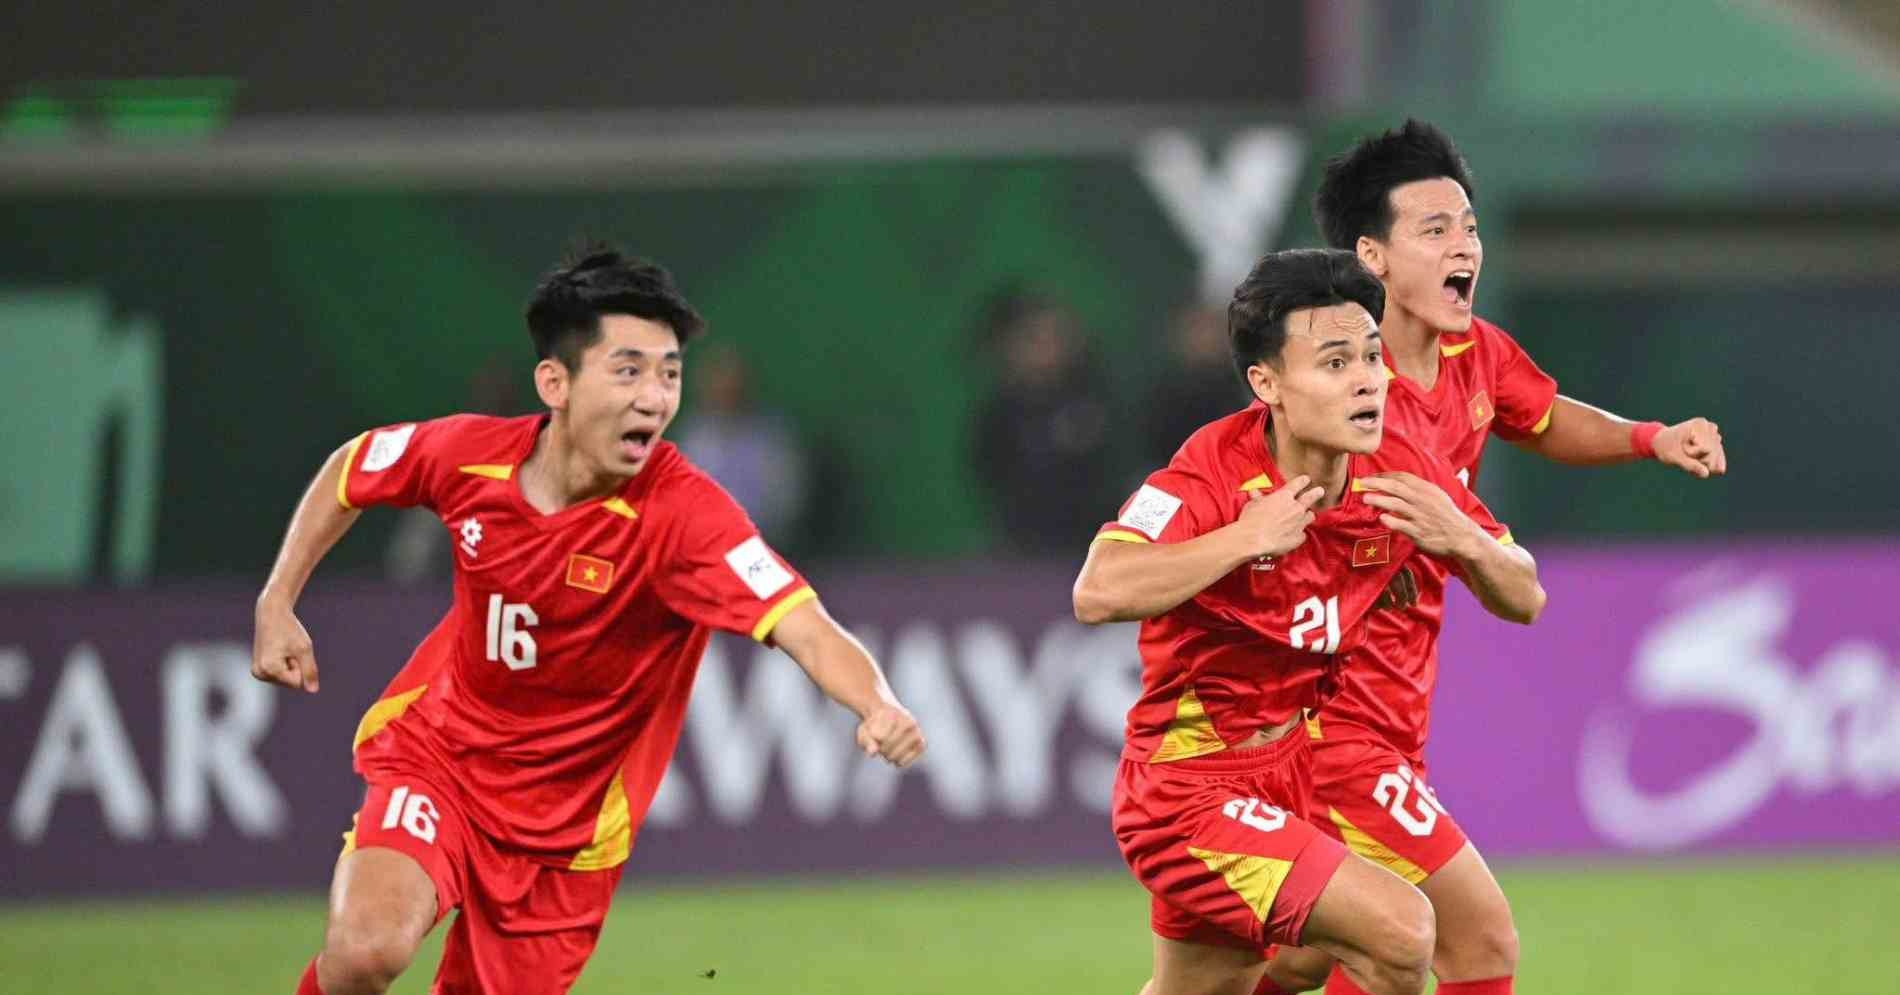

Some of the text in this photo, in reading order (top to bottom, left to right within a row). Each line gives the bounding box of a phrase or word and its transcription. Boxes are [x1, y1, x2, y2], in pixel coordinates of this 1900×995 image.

[486, 593, 539, 671] 16
[1290, 594, 1341, 654] 21
[0, 616, 1141, 842] AR WAYS
[381, 785, 440, 845] 16
[1372, 764, 1449, 836] 2
